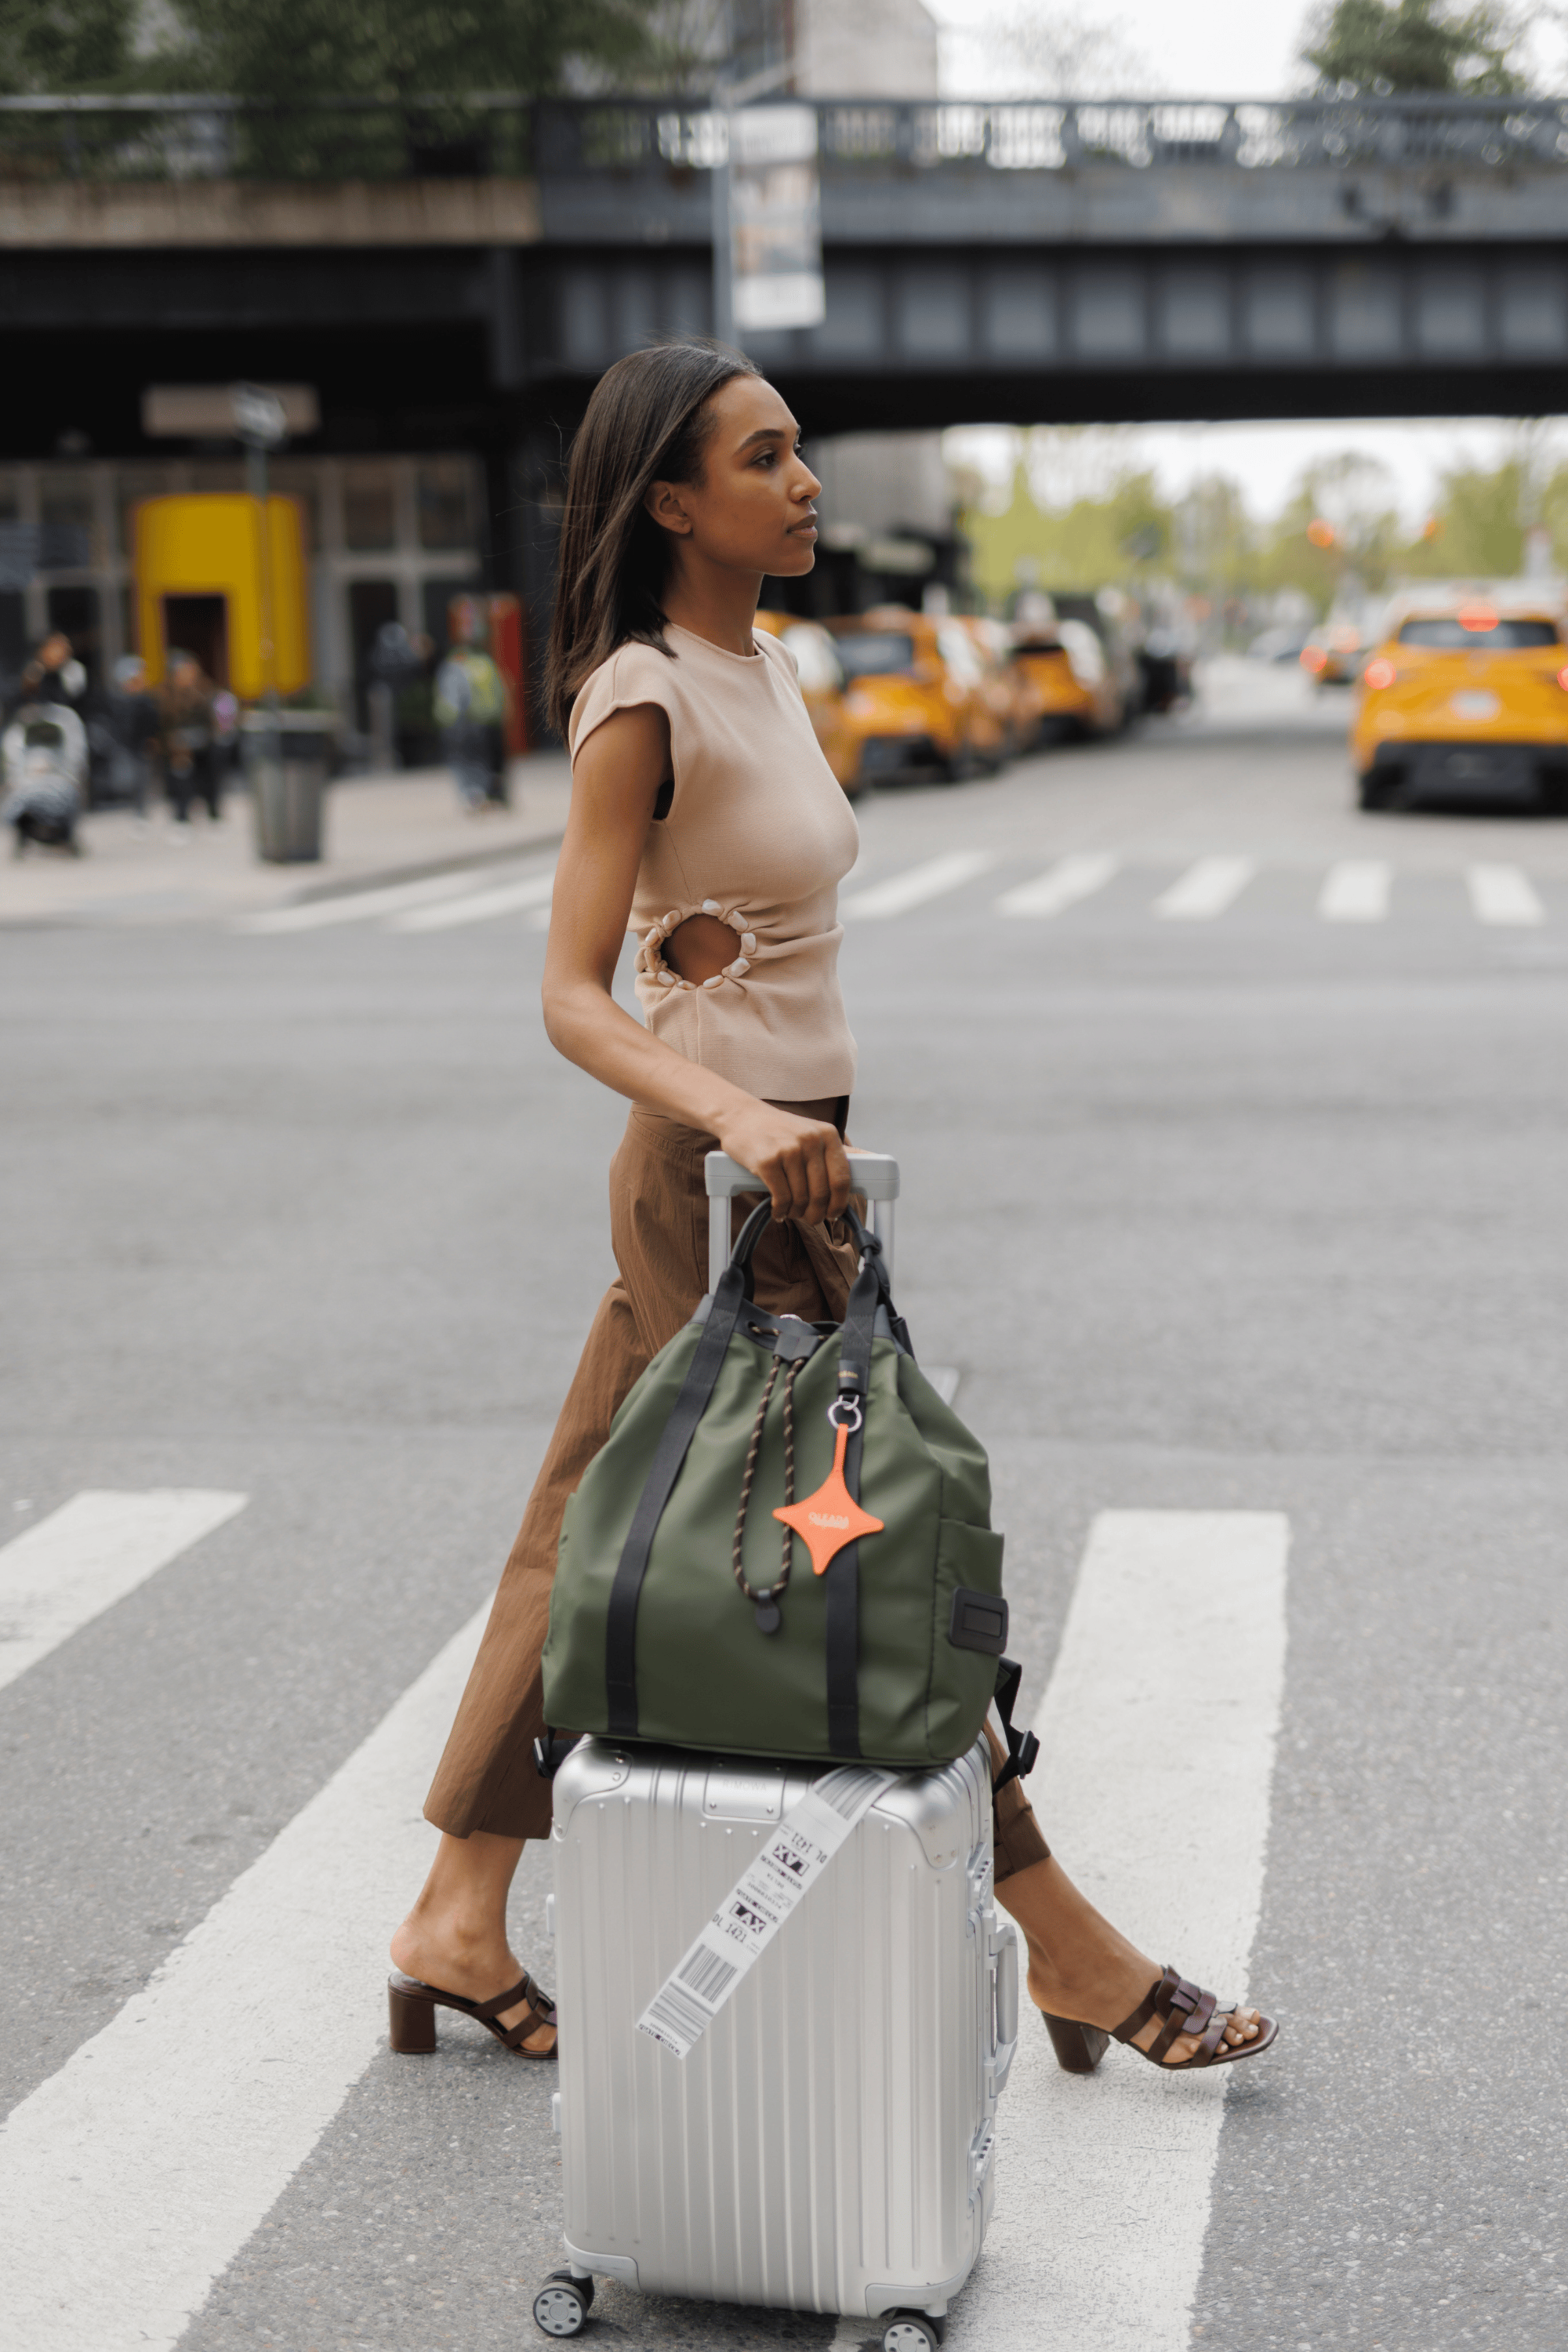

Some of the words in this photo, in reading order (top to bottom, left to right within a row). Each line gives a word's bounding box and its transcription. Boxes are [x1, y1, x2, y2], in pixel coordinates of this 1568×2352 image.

[723, 1778, 767, 1791] RIMOWA
[792, 1832, 813, 1853] 1421
[773, 1844, 809, 1875] LAX
[816, 1850, 828, 1864] DL
[713, 1914, 723, 1927] DL
[725, 1923, 746, 1943] 1421
[730, 1902, 766, 1934] LAX
